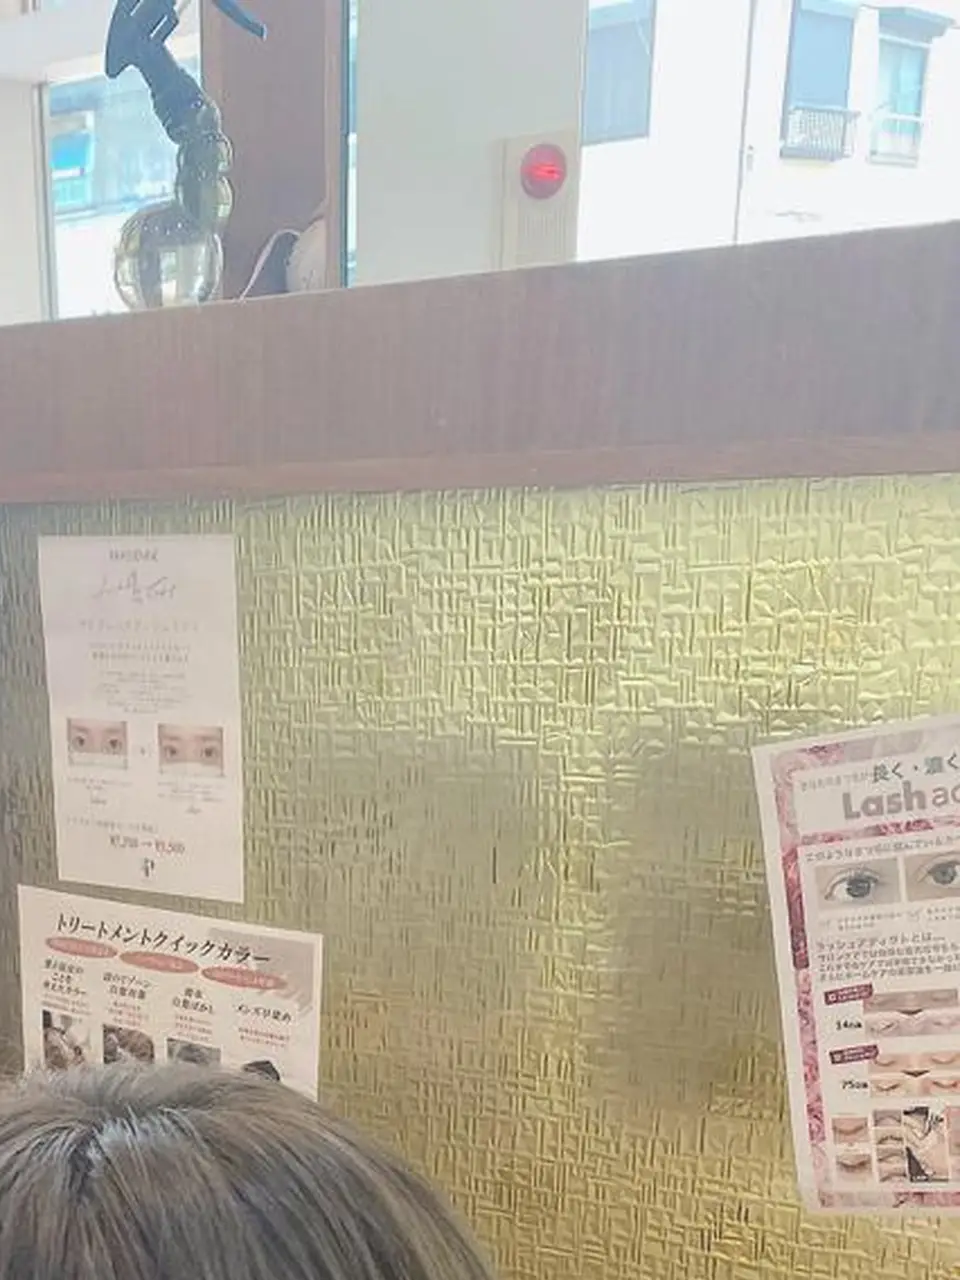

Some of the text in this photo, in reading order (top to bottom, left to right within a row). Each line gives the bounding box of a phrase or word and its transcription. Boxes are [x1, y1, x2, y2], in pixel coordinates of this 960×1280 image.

[842, 780, 927, 820] Lash
[56, 913, 271, 964] トリートメントクイックカラー
